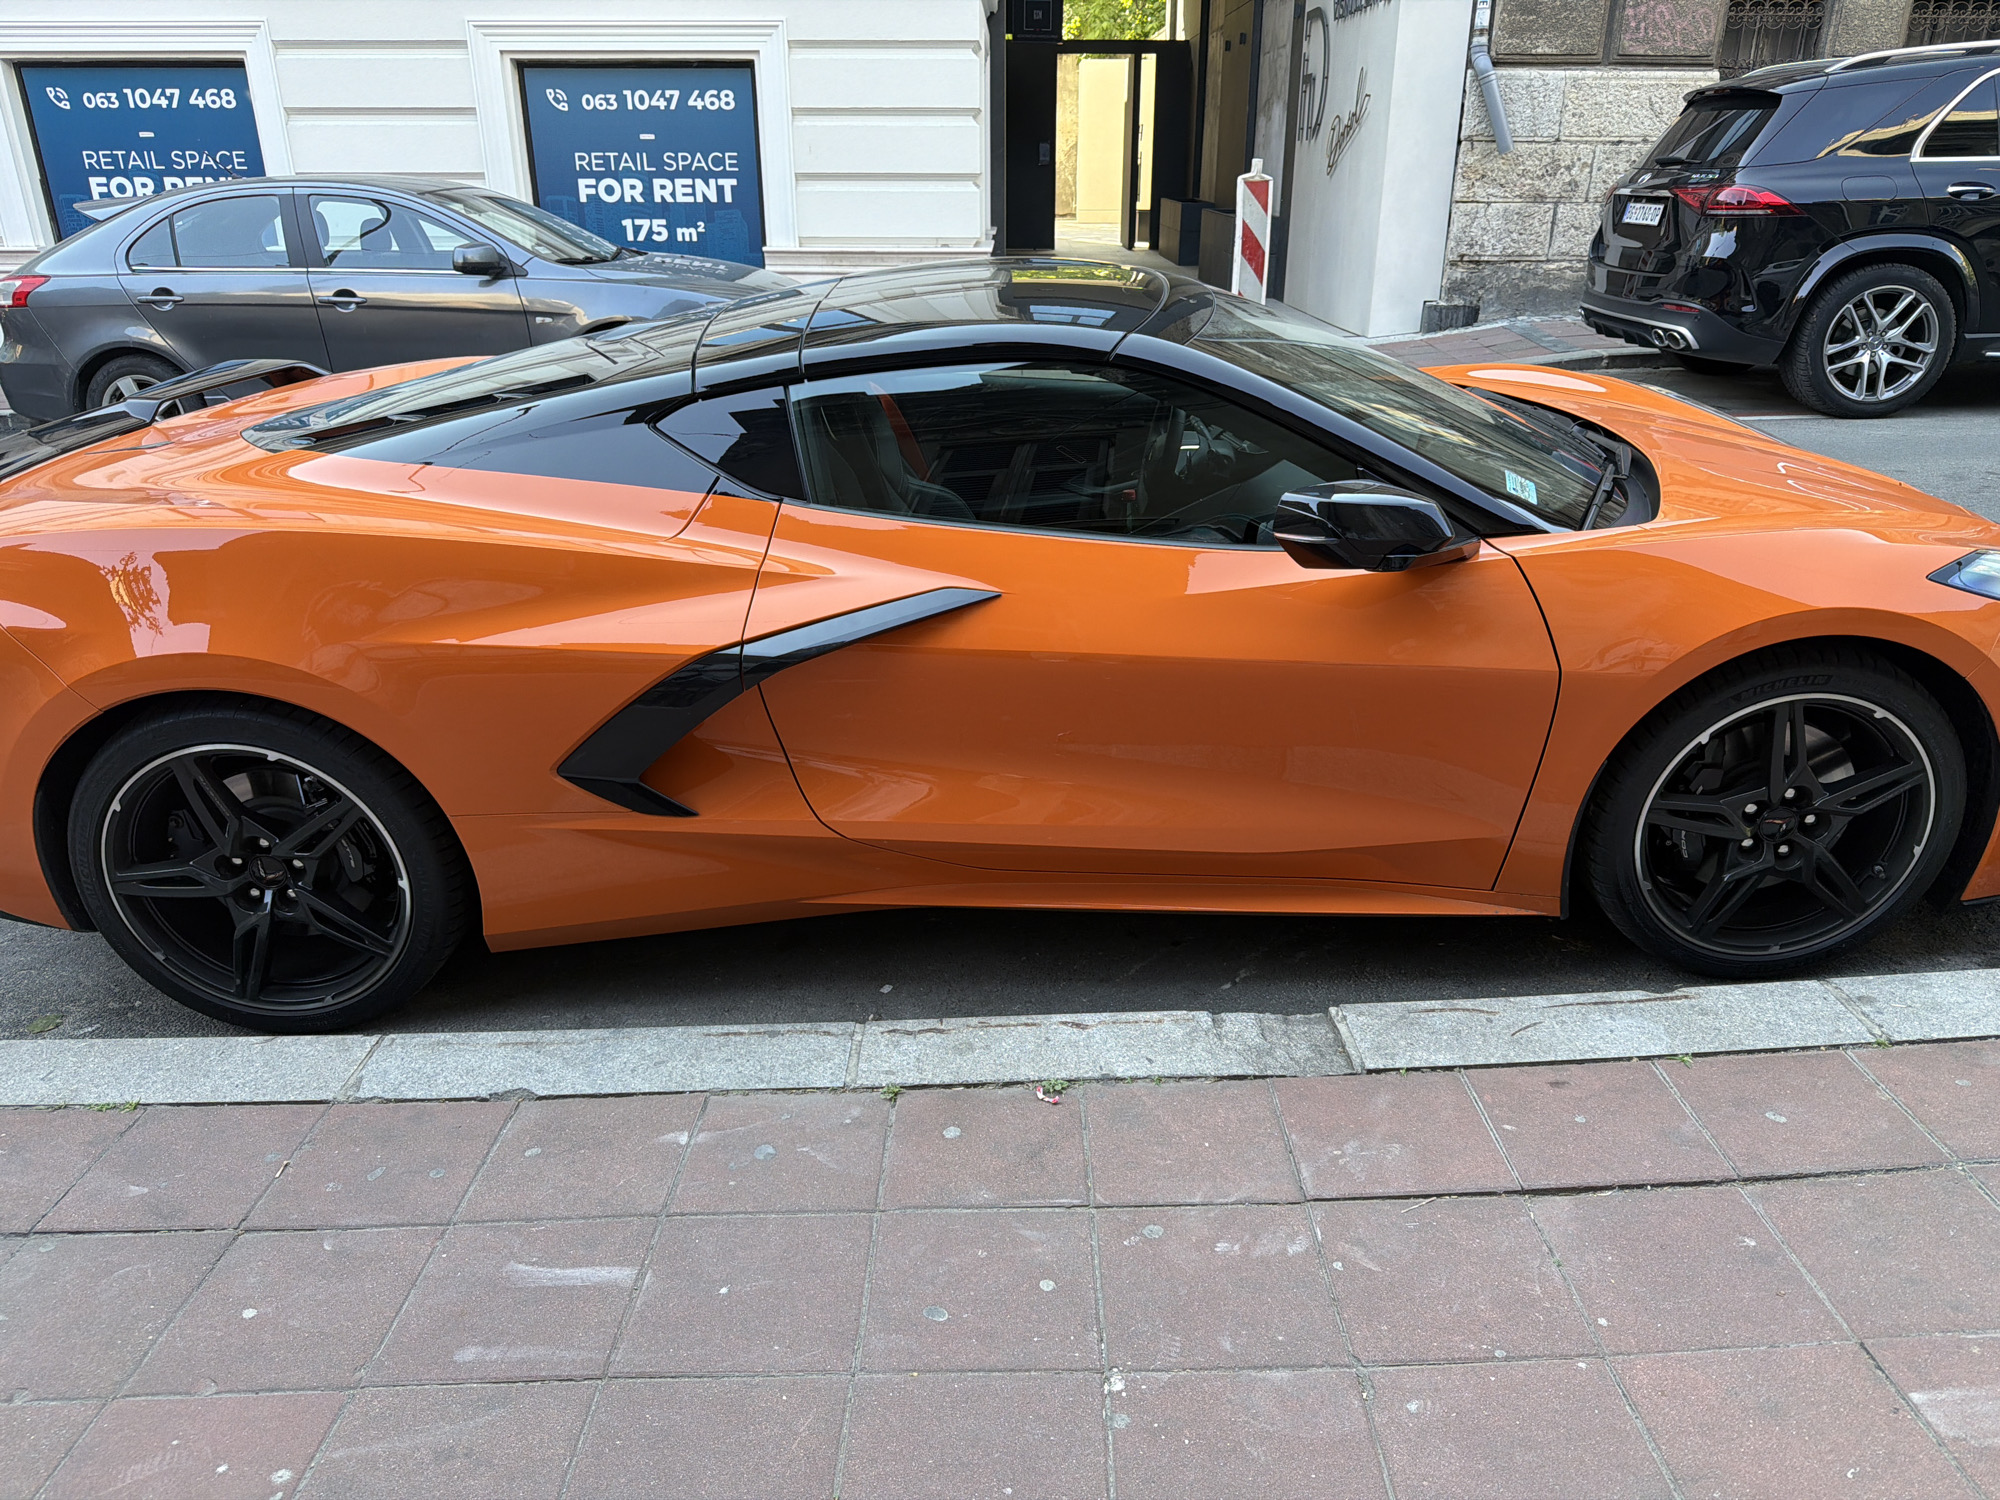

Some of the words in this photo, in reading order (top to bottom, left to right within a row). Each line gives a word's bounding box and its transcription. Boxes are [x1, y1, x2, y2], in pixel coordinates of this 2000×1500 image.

[83, 93, 119, 109] 063
[122, 88, 180, 109] 1047
[189, 88, 237, 109] 468
[581, 93, 618, 111] 063
[622, 89, 680, 111] 1047
[687, 89, 736, 111] 468
[82, 150, 166, 170] RETAIL
[170, 150, 248, 170] SPACE
[574, 152, 657, 171] RETAIL
[663, 152, 739, 171] SPACE
[88, 176, 155, 200] FOR
[577, 178, 645, 203] FOR
[652, 178, 738, 203] RENT
[621, 218, 669, 242] 175
[1739, 675, 1832, 699] MICHELIN
